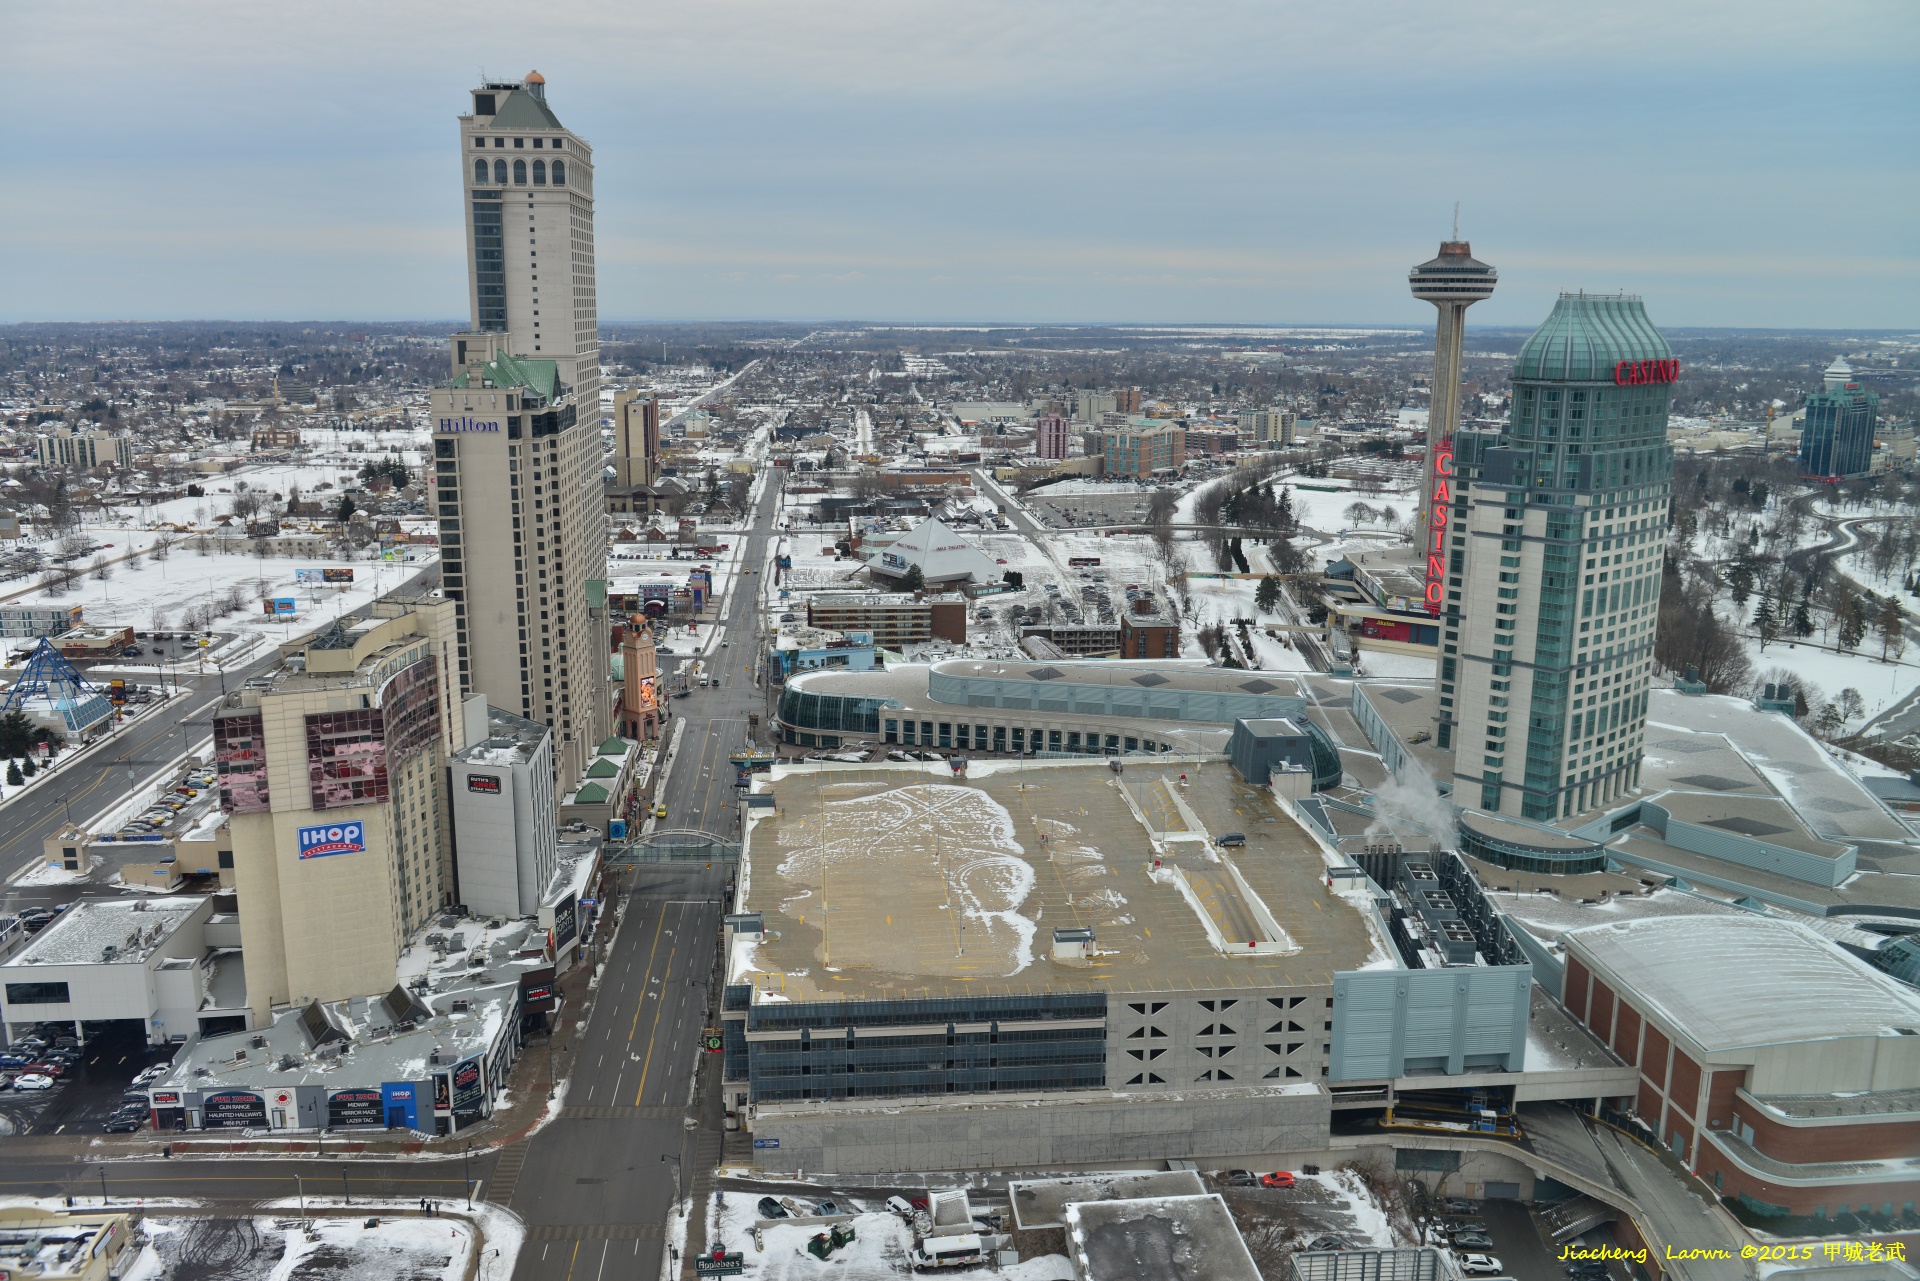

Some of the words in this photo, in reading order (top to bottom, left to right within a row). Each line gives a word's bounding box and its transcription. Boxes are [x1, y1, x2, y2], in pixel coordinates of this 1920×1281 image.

[1615, 358, 1679, 386] CASINO
[440, 416, 500, 432] Hilton
[1426, 453, 1453, 603] CASINO
[473, 781, 497, 789] CHRIS
[302, 825, 360, 846] IHOP
[307, 844, 357, 855] RESTAURANT
[556, 909, 568, 926] FOUR
[556, 915, 573, 935] POINTS
[456, 1072, 478, 1088] ZONE
[459, 1068, 475, 1080] FUN
[212, 1095, 230, 1103] FUN
